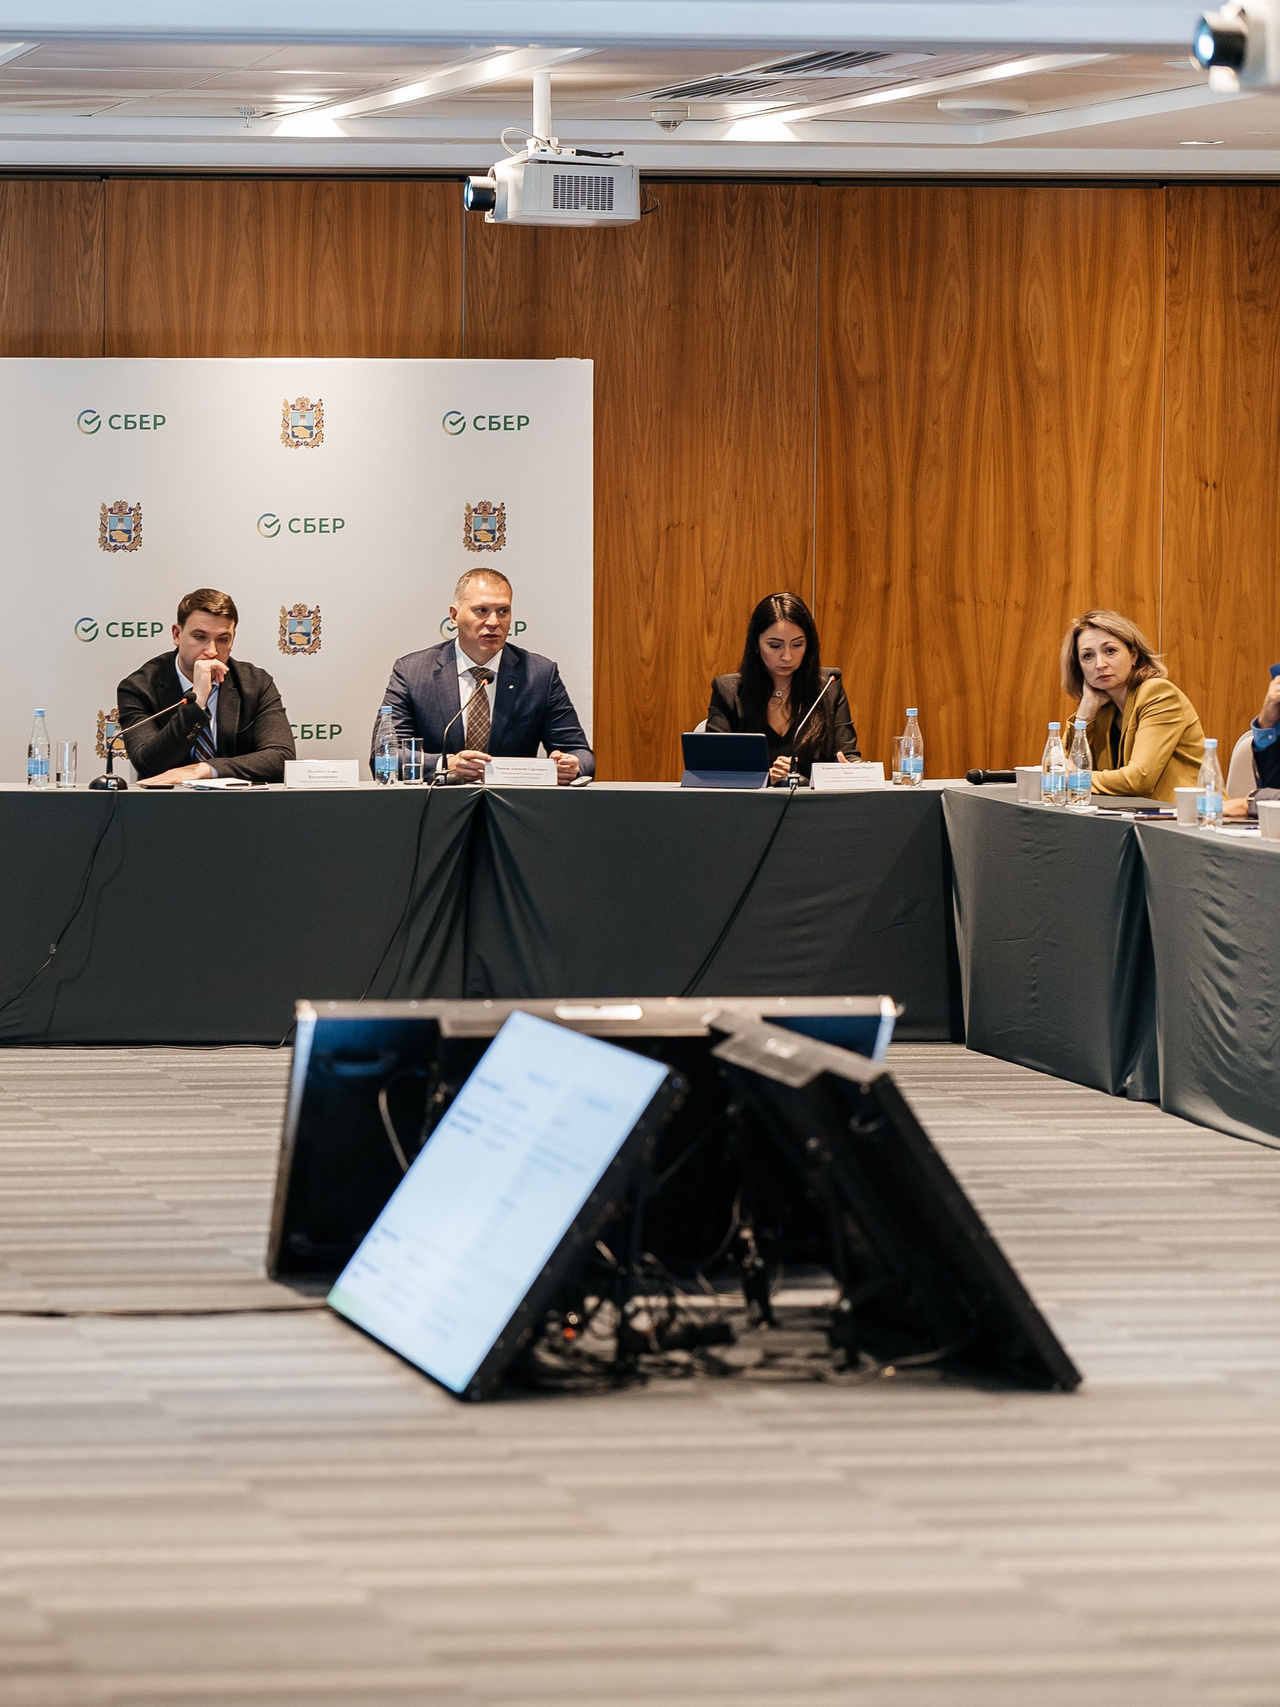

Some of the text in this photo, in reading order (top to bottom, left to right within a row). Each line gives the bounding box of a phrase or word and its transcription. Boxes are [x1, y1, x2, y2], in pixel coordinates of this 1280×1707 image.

[109, 413, 167, 431] СБЕР
[472, 414, 530, 431] СБЕР
[287, 517, 346, 534] СБЕР
[106, 621, 164, 638] СБЕР
